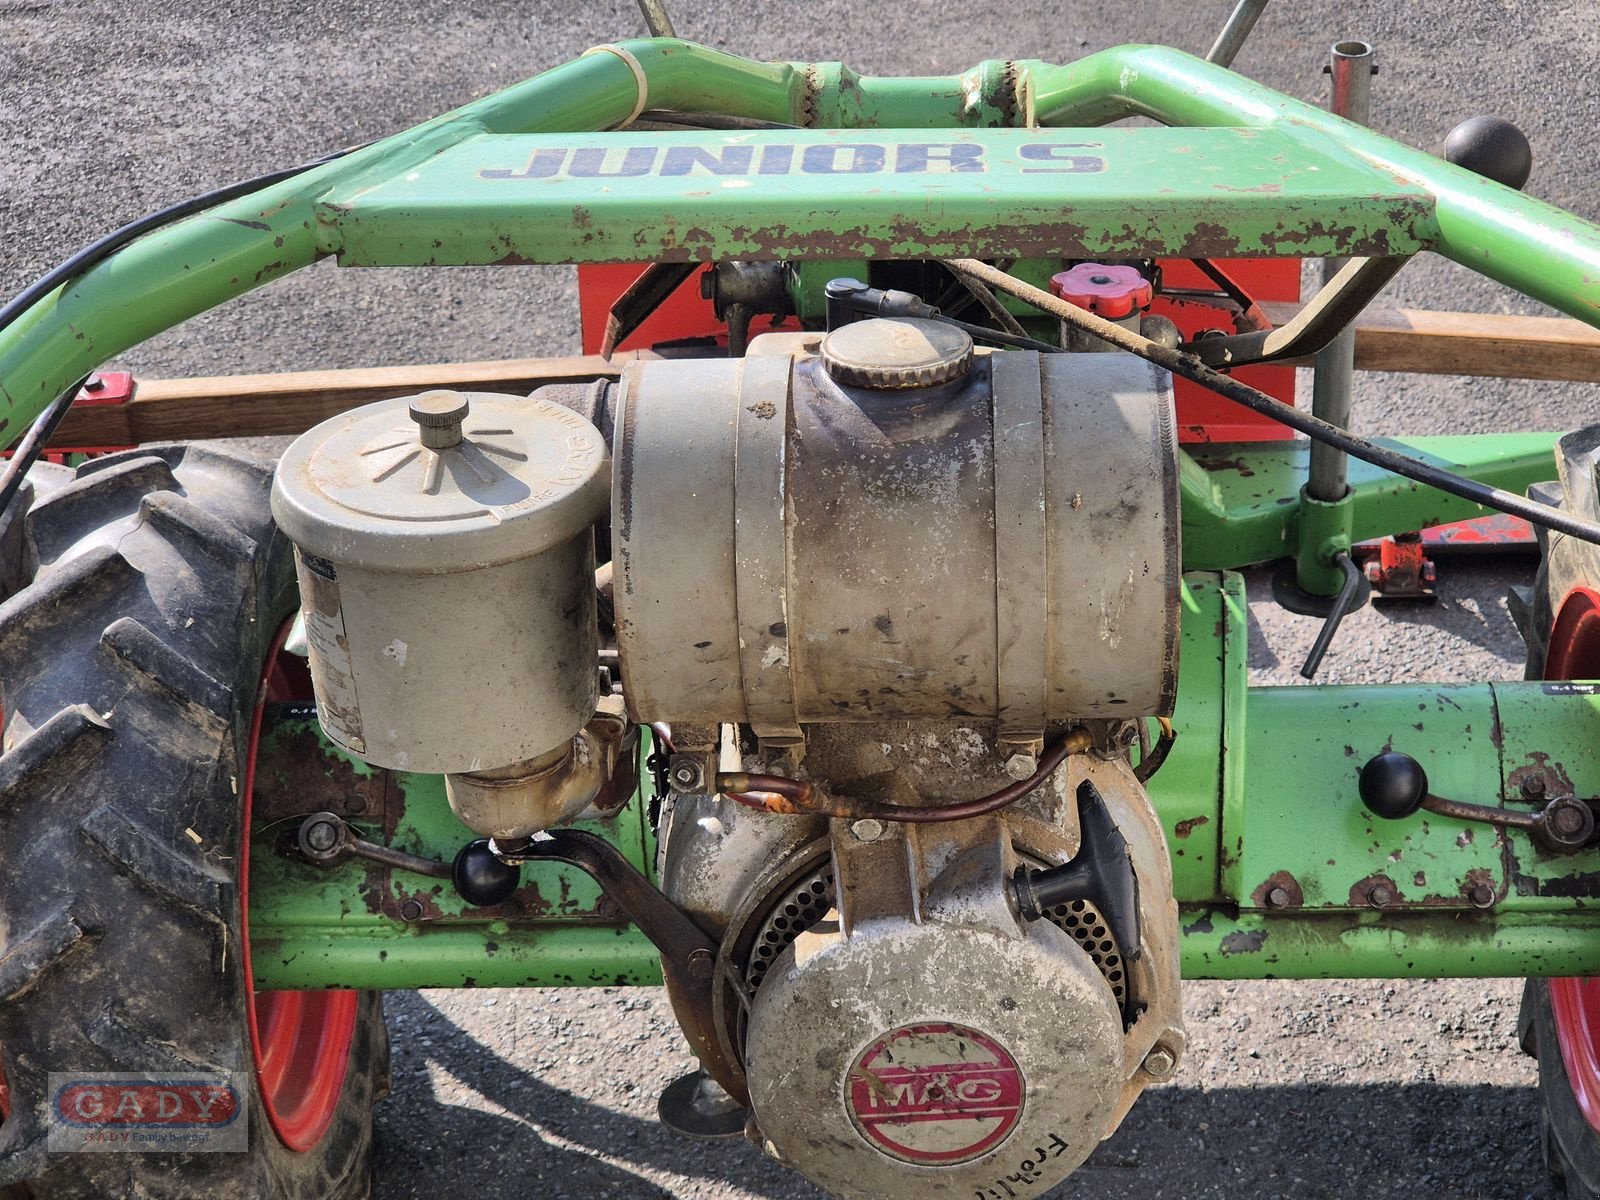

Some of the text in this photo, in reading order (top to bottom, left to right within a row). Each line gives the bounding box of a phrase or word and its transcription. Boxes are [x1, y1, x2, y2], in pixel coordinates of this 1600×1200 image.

[479, 143, 1105, 179] JUNIOR S
[869, 1079, 1002, 1108] MAG
